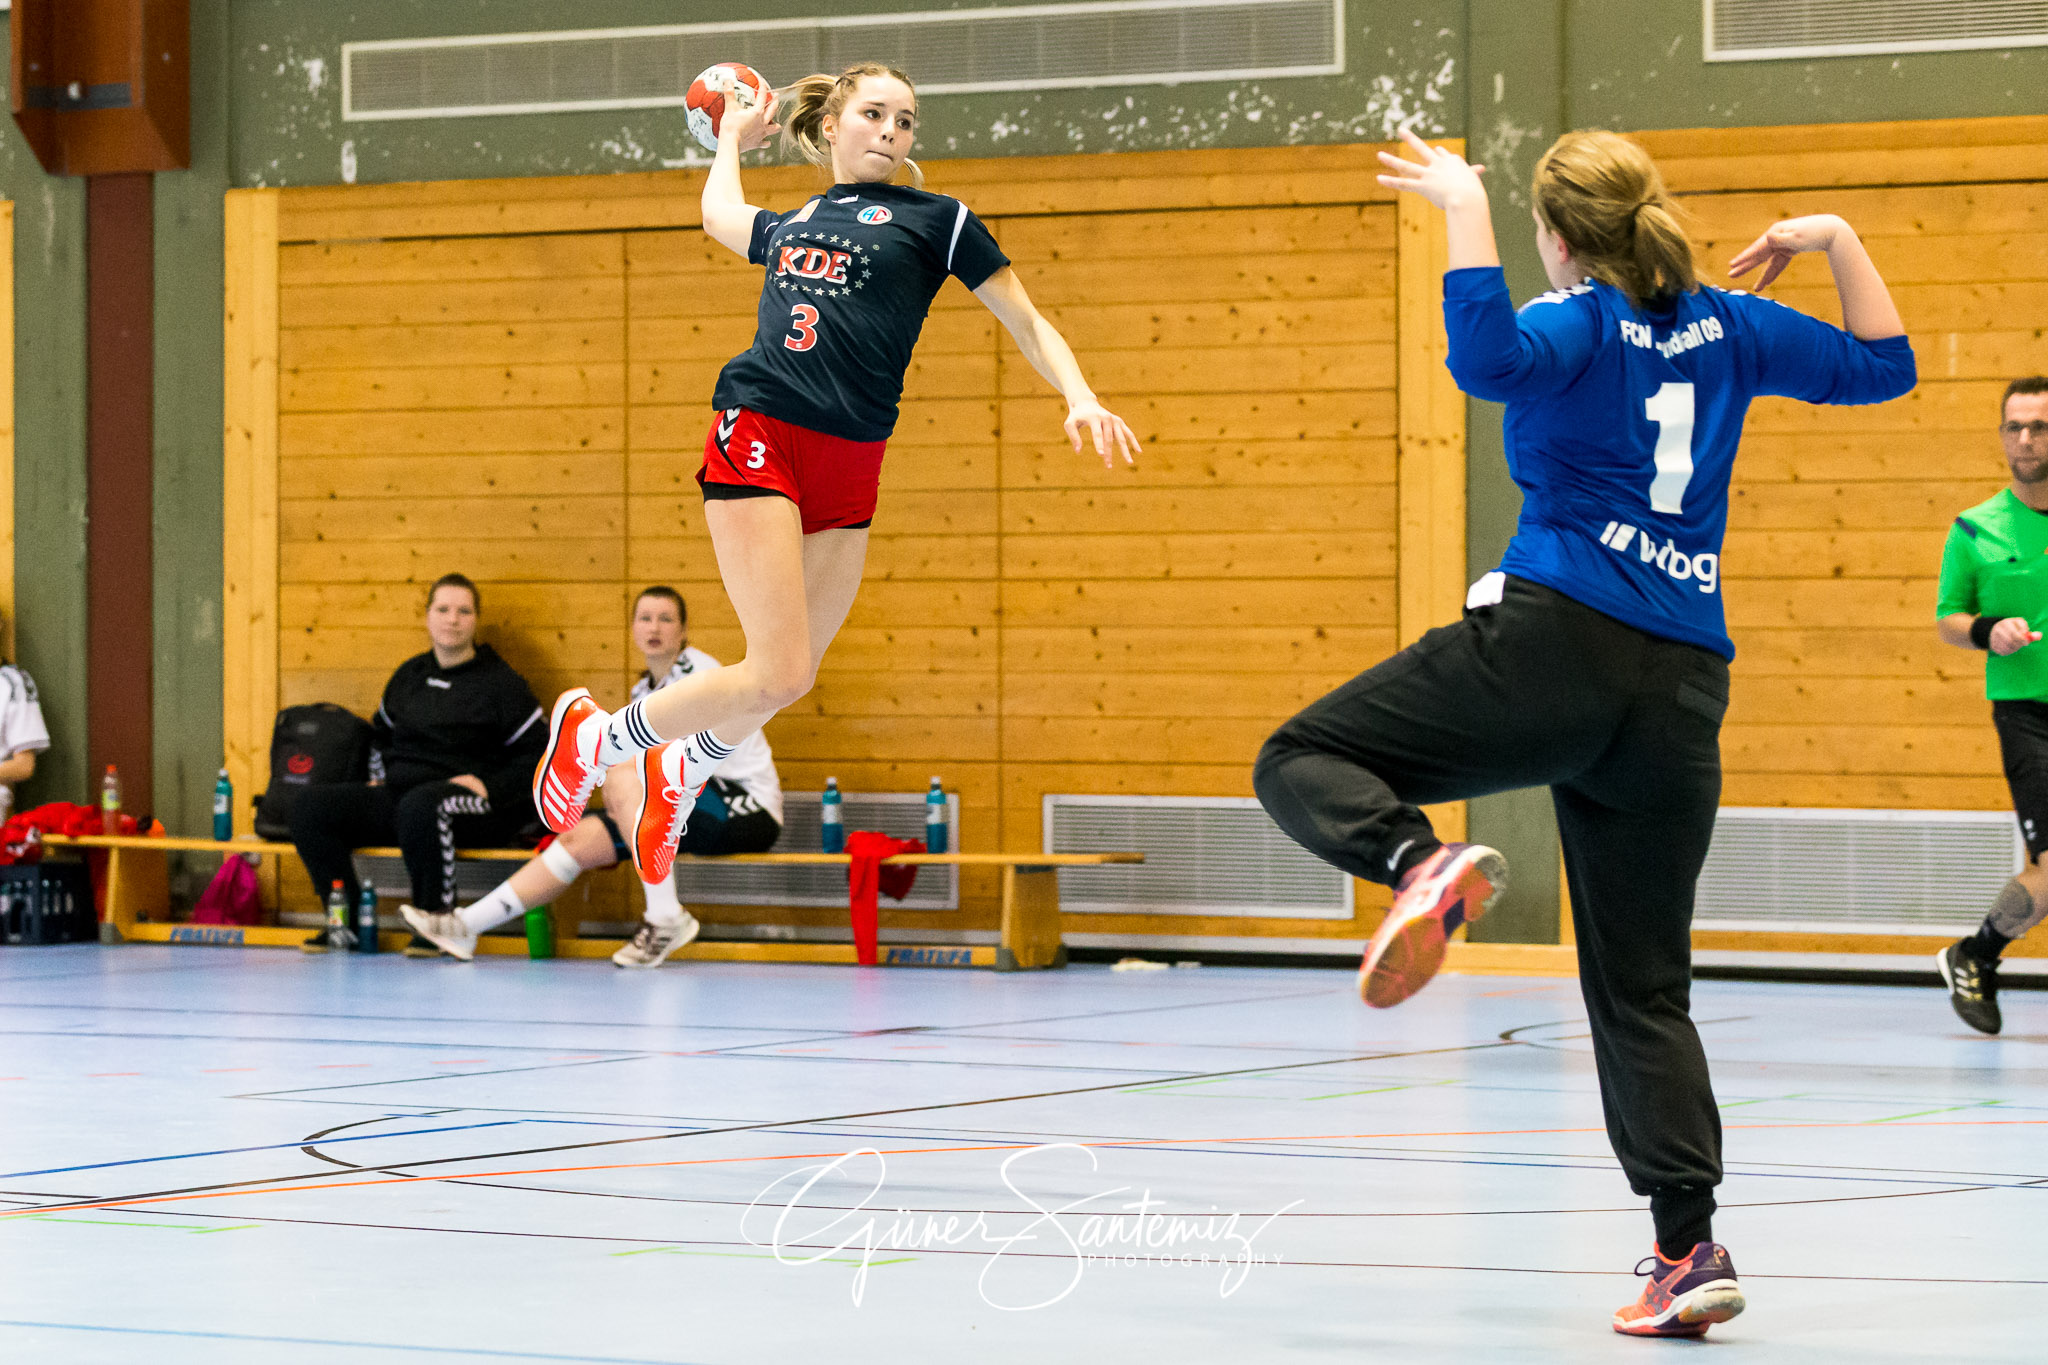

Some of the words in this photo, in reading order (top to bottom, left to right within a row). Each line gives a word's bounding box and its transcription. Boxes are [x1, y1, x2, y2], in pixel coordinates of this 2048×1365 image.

[775, 246, 852, 285] KDE
[784, 303, 820, 352] 3
[1620, 319, 1652, 349] FCN
[1699, 315, 1724, 342] 09
[746, 440, 767, 470] 3
[1645, 382, 1695, 515] 1
